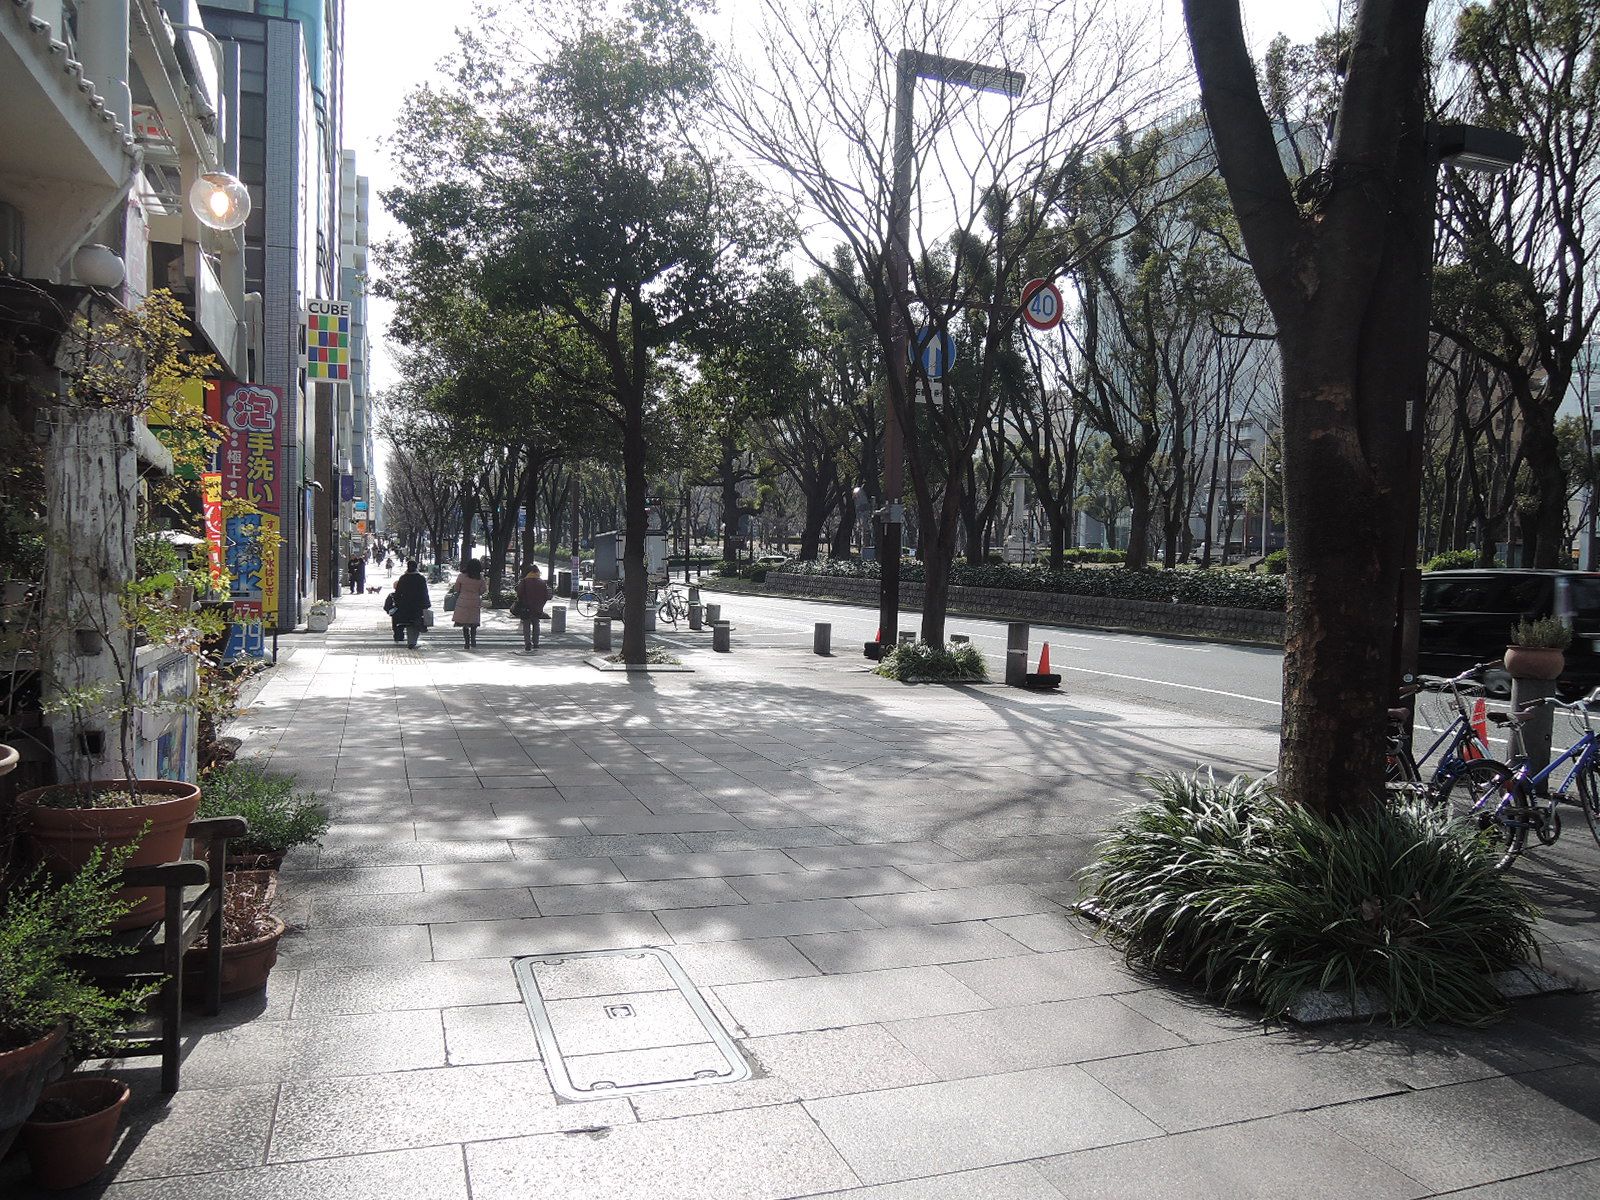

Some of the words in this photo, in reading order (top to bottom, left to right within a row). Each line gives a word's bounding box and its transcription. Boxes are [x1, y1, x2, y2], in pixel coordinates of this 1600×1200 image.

[308, 302, 349, 316] CUBE
[1030, 293, 1054, 316] 40
[233, 387, 275, 503] 泡手洗い
